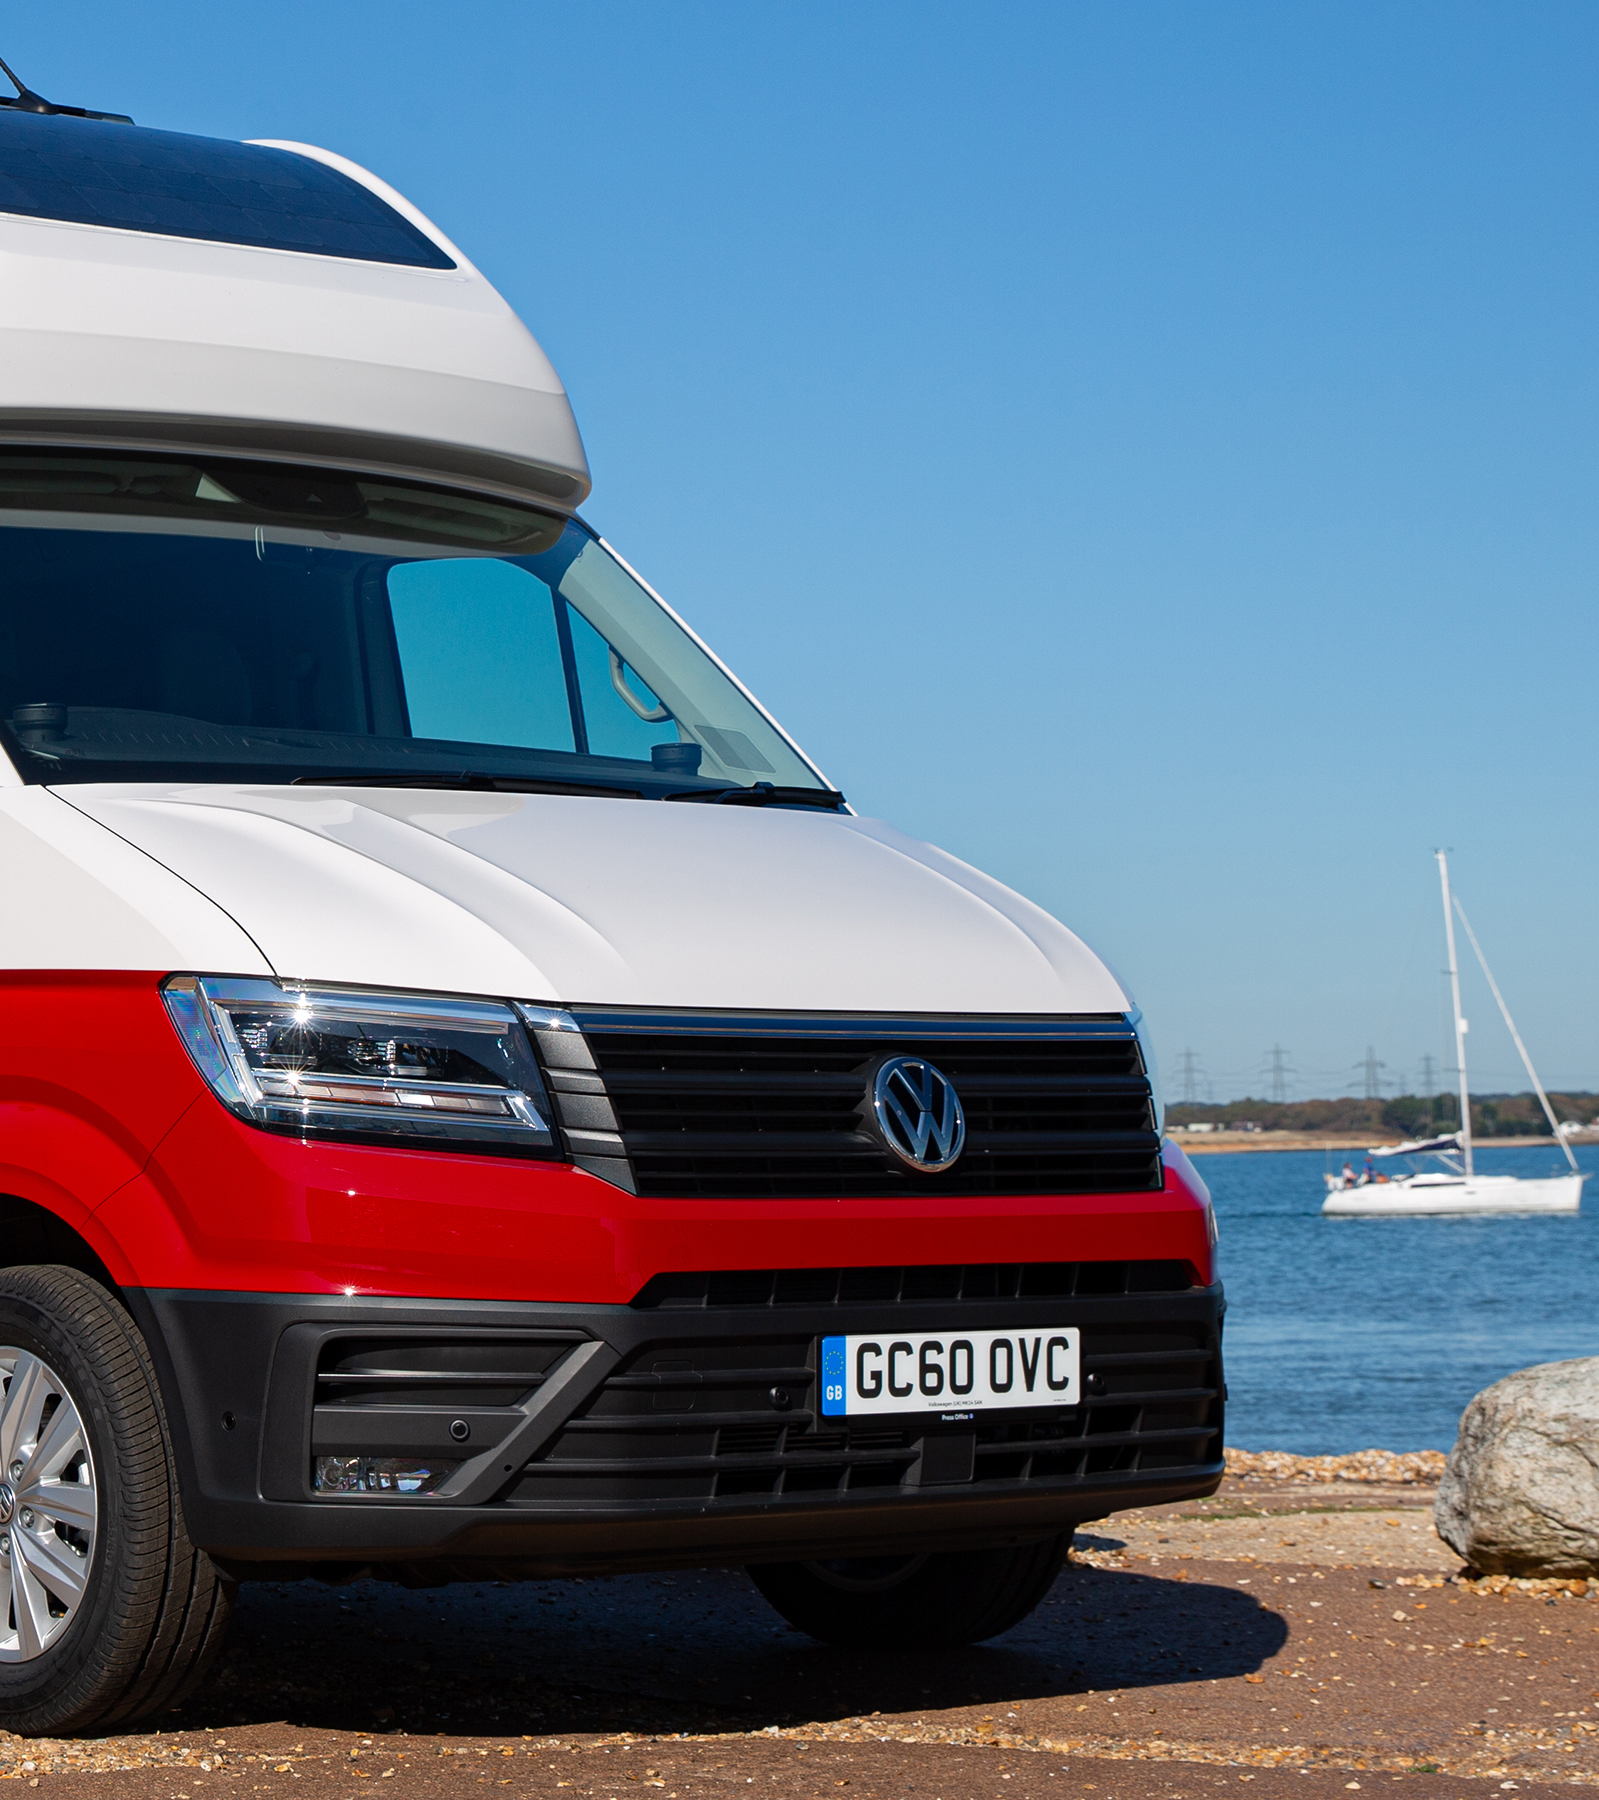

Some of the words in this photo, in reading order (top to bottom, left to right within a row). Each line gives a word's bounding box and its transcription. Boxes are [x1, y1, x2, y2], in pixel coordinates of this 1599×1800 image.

[875, 1056, 965, 1173] VW
[826, 1385, 843, 1401] GB
[856, 1339, 974, 1399] GC60
[989, 1336, 1070, 1394] OVC
